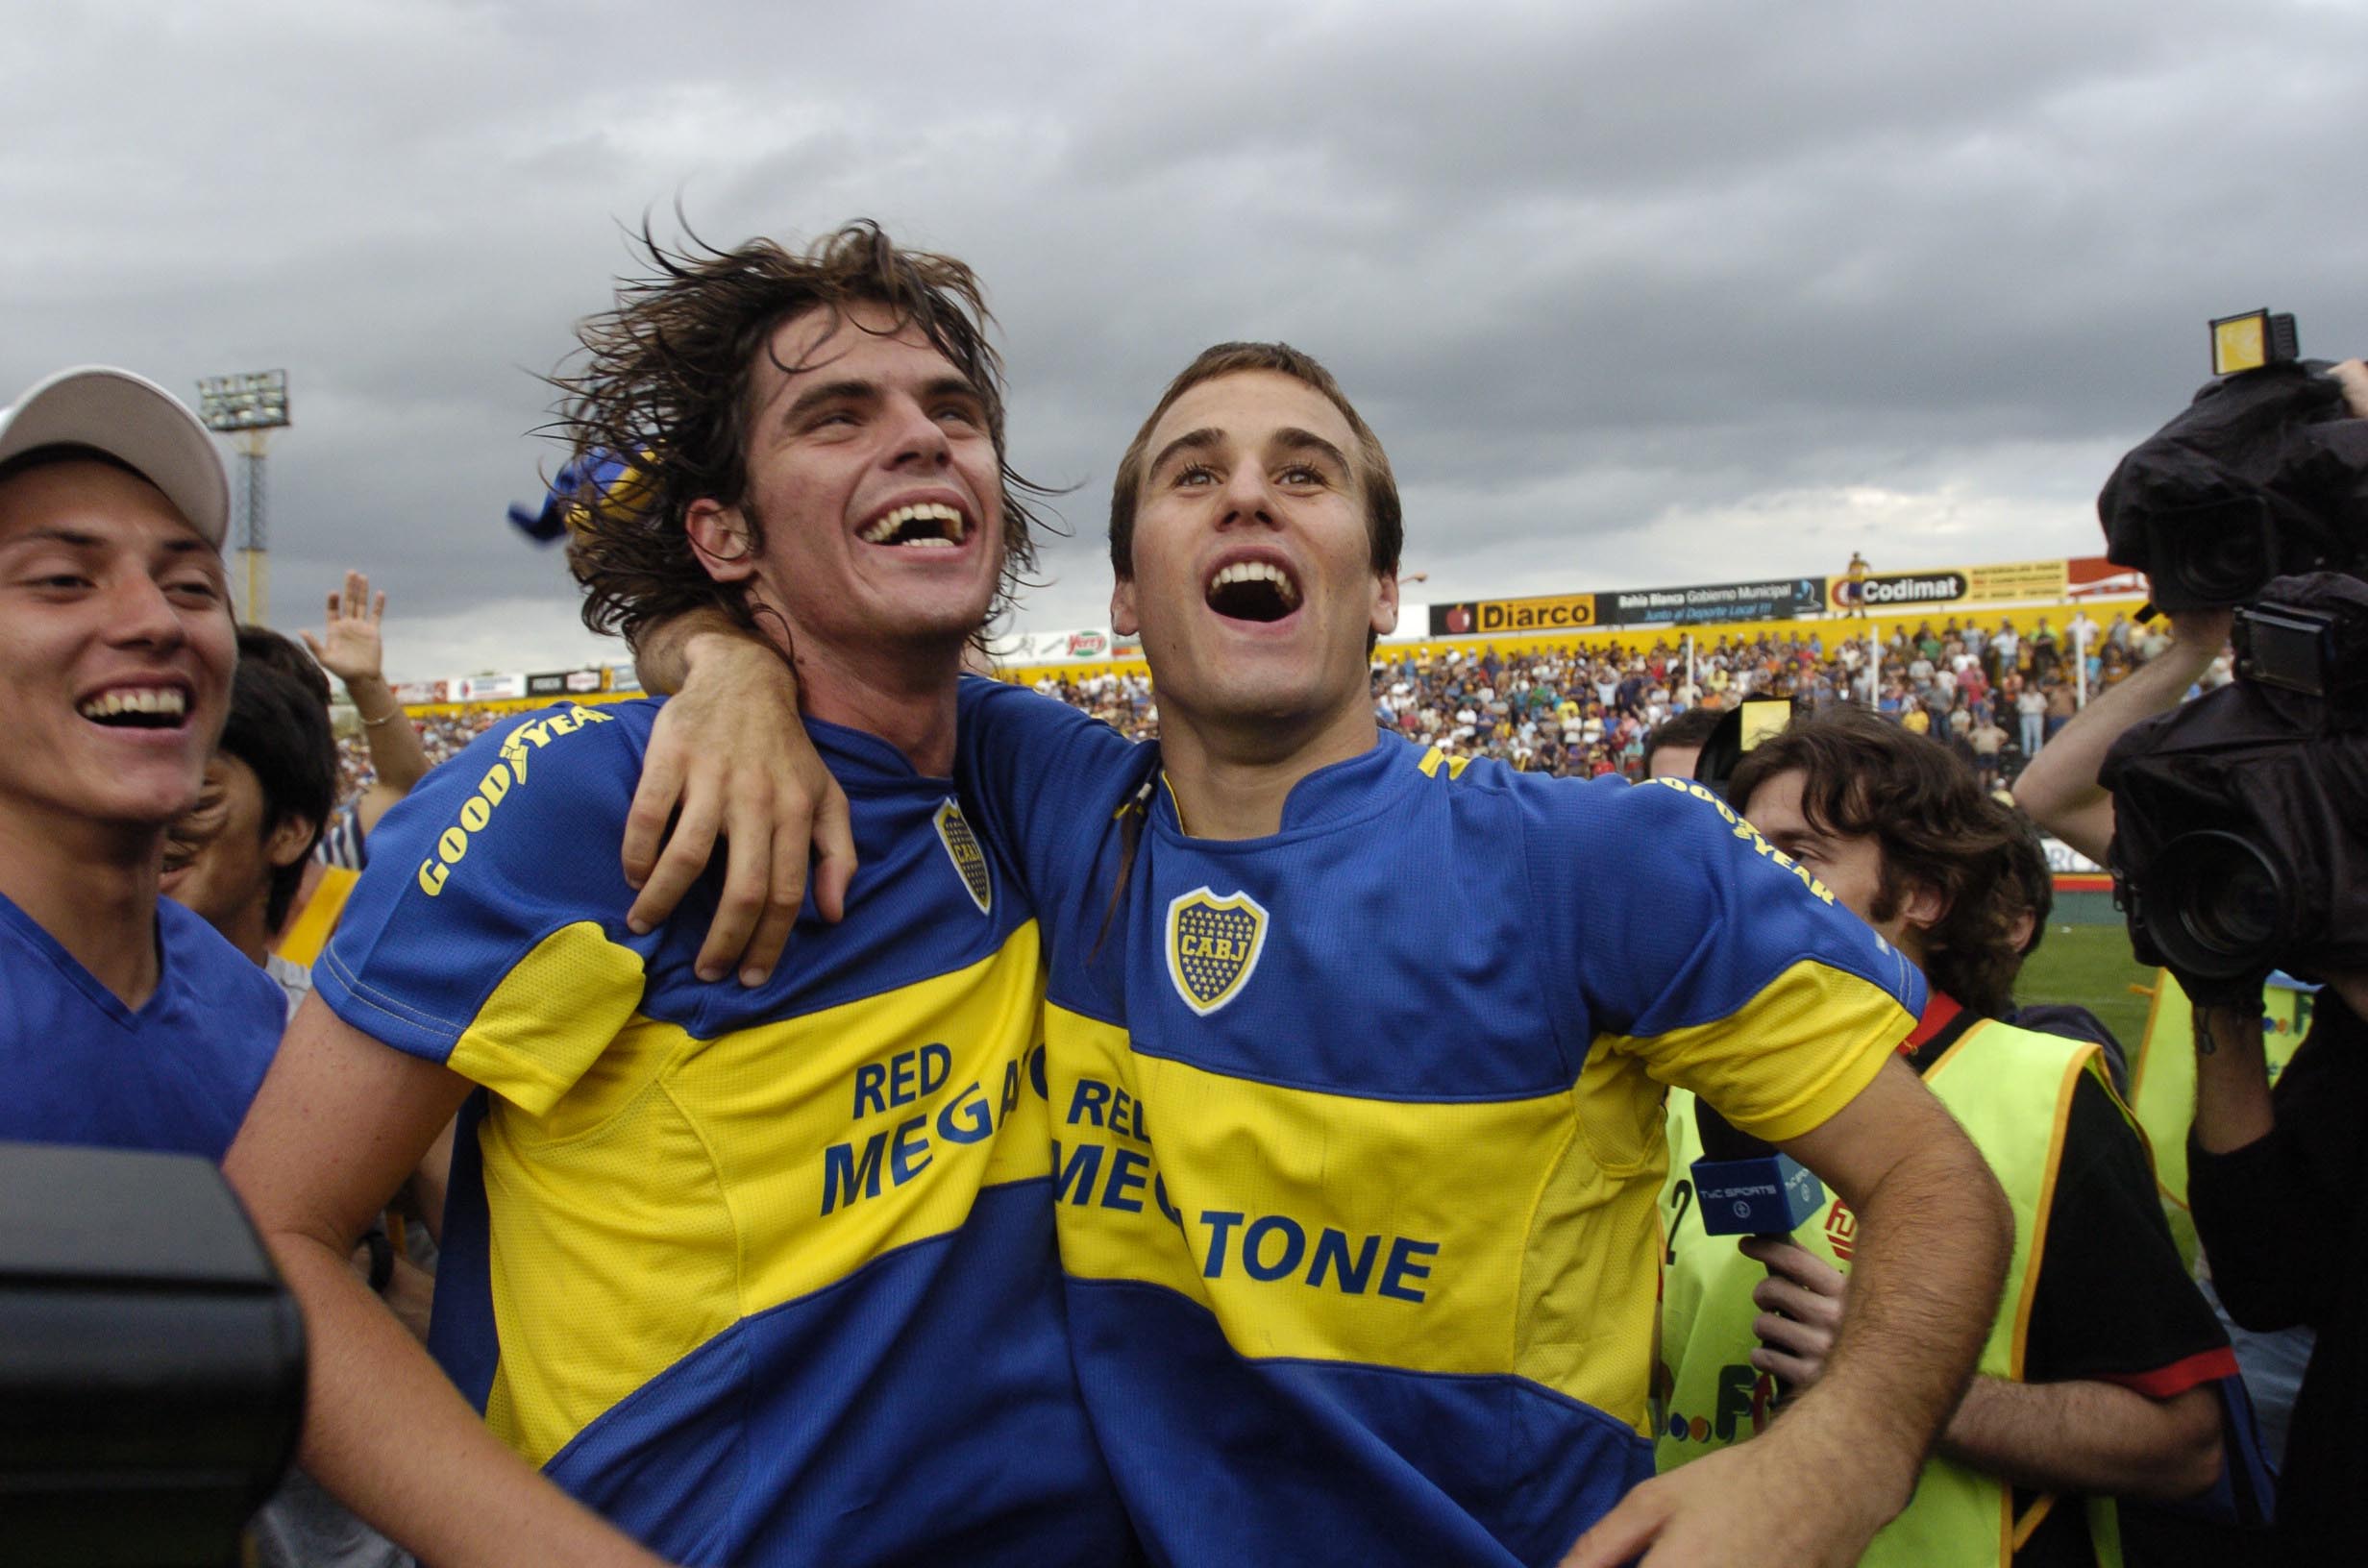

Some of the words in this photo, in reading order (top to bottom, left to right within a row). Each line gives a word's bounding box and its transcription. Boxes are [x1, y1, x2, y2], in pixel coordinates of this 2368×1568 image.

[1862, 576, 1958, 601] Codimat
[1483, 603, 1590, 628] Diarco
[1633, 777, 1835, 906] OODYEAR
[1181, 934, 1247, 962] CABJ
[853, 1042, 951, 1120] RED
[1724, 1184, 1777, 1198] SPORTS
